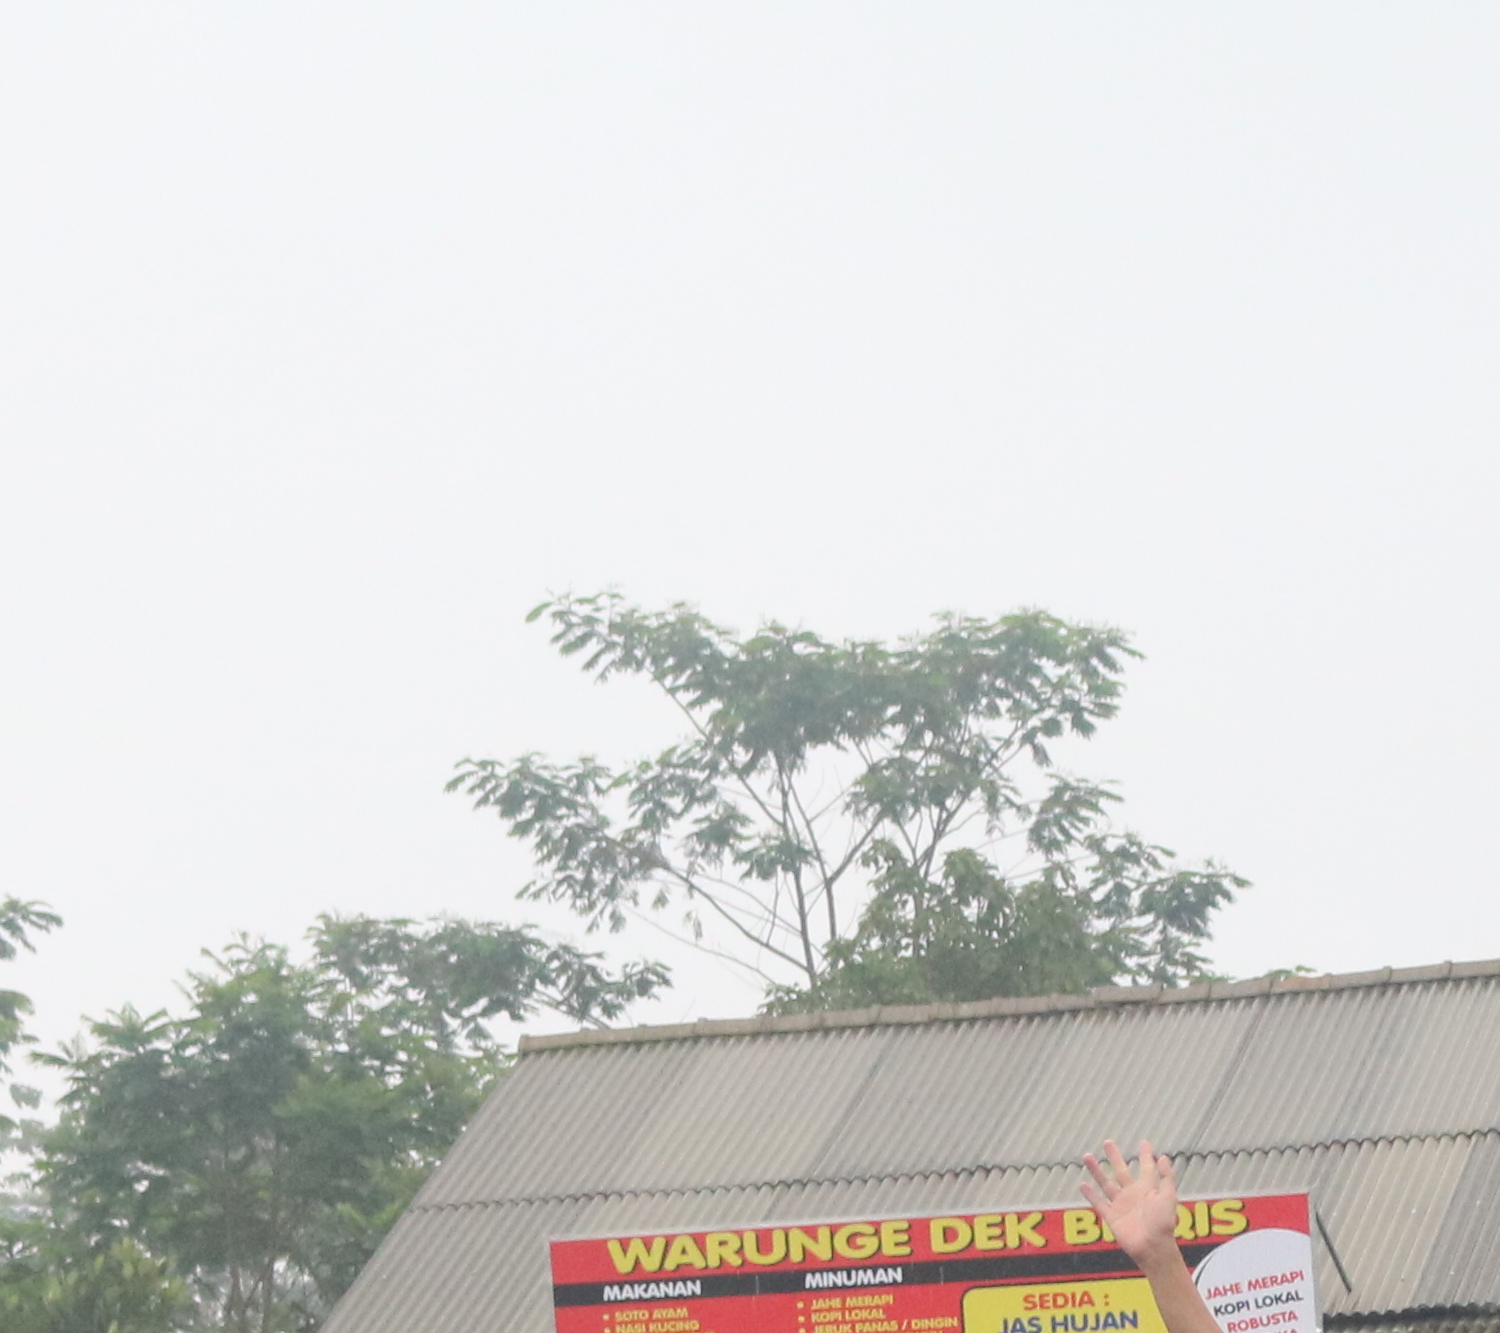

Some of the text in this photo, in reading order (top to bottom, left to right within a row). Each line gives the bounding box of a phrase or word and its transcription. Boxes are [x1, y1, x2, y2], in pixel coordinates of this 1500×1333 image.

[607, 1219, 912, 1274] WARUNGE
[930, 1211, 1047, 1254] DEK
[804, 1267, 903, 1289] MINUMAN
[1205, 1269, 1305, 1301] JAHE MERAPI
[603, 1280, 702, 1302] MAKANAN
[811, 1294, 894, 1310] JAHE MERAPI
[1022, 1291, 1096, 1310] SEDIA
[615, 1307, 689, 1322] SOTO AYAM
[1214, 1290, 1304, 1317] KOPI LOKAL
[649, 1319, 700, 1333] KUCING
[811, 1308, 886, 1323] KOPI LOKAL
[853, 1321, 898, 1333] PANAS
[911, 1316, 959, 1330] DINGIN
[1051, 1310, 1139, 1333] HUJAN
[1227, 1309, 1300, 1333] ROBUSTA
